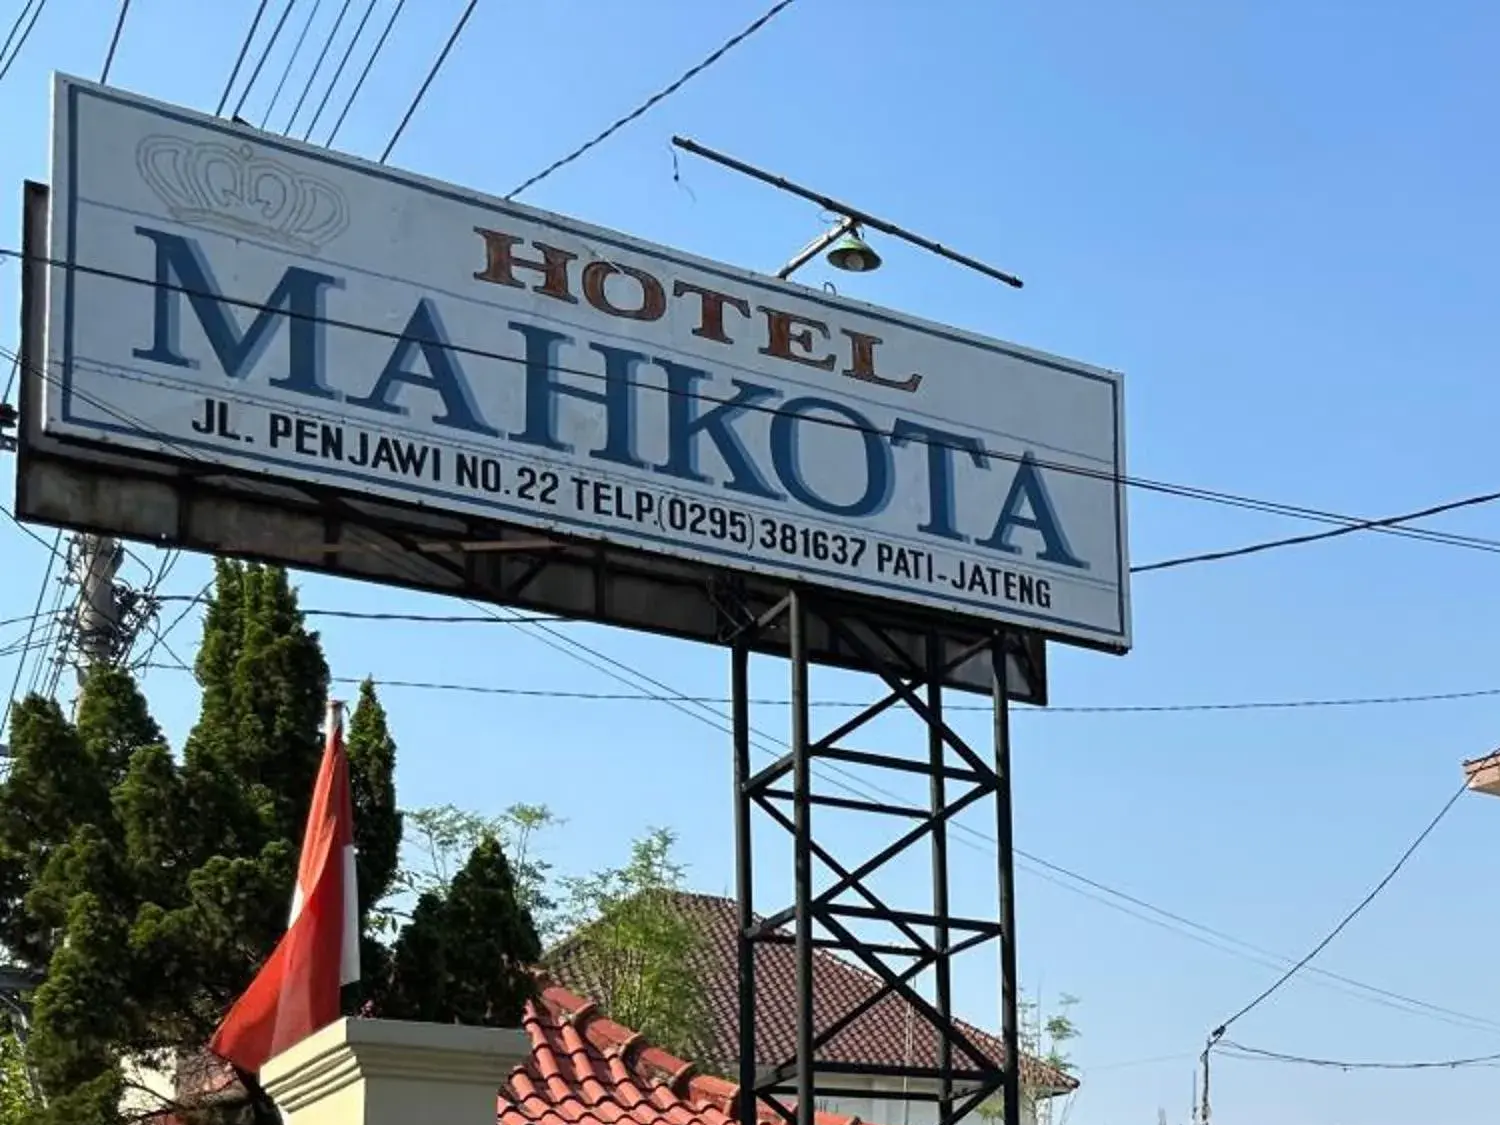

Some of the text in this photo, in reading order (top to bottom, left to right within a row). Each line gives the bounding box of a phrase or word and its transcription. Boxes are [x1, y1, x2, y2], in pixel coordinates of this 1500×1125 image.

[473, 226, 923, 393] HOTEL
[133, 226, 1091, 569] MAHKOTA
[192, 398, 254, 443] JL.
[270, 413, 441, 482] PENJAWI
